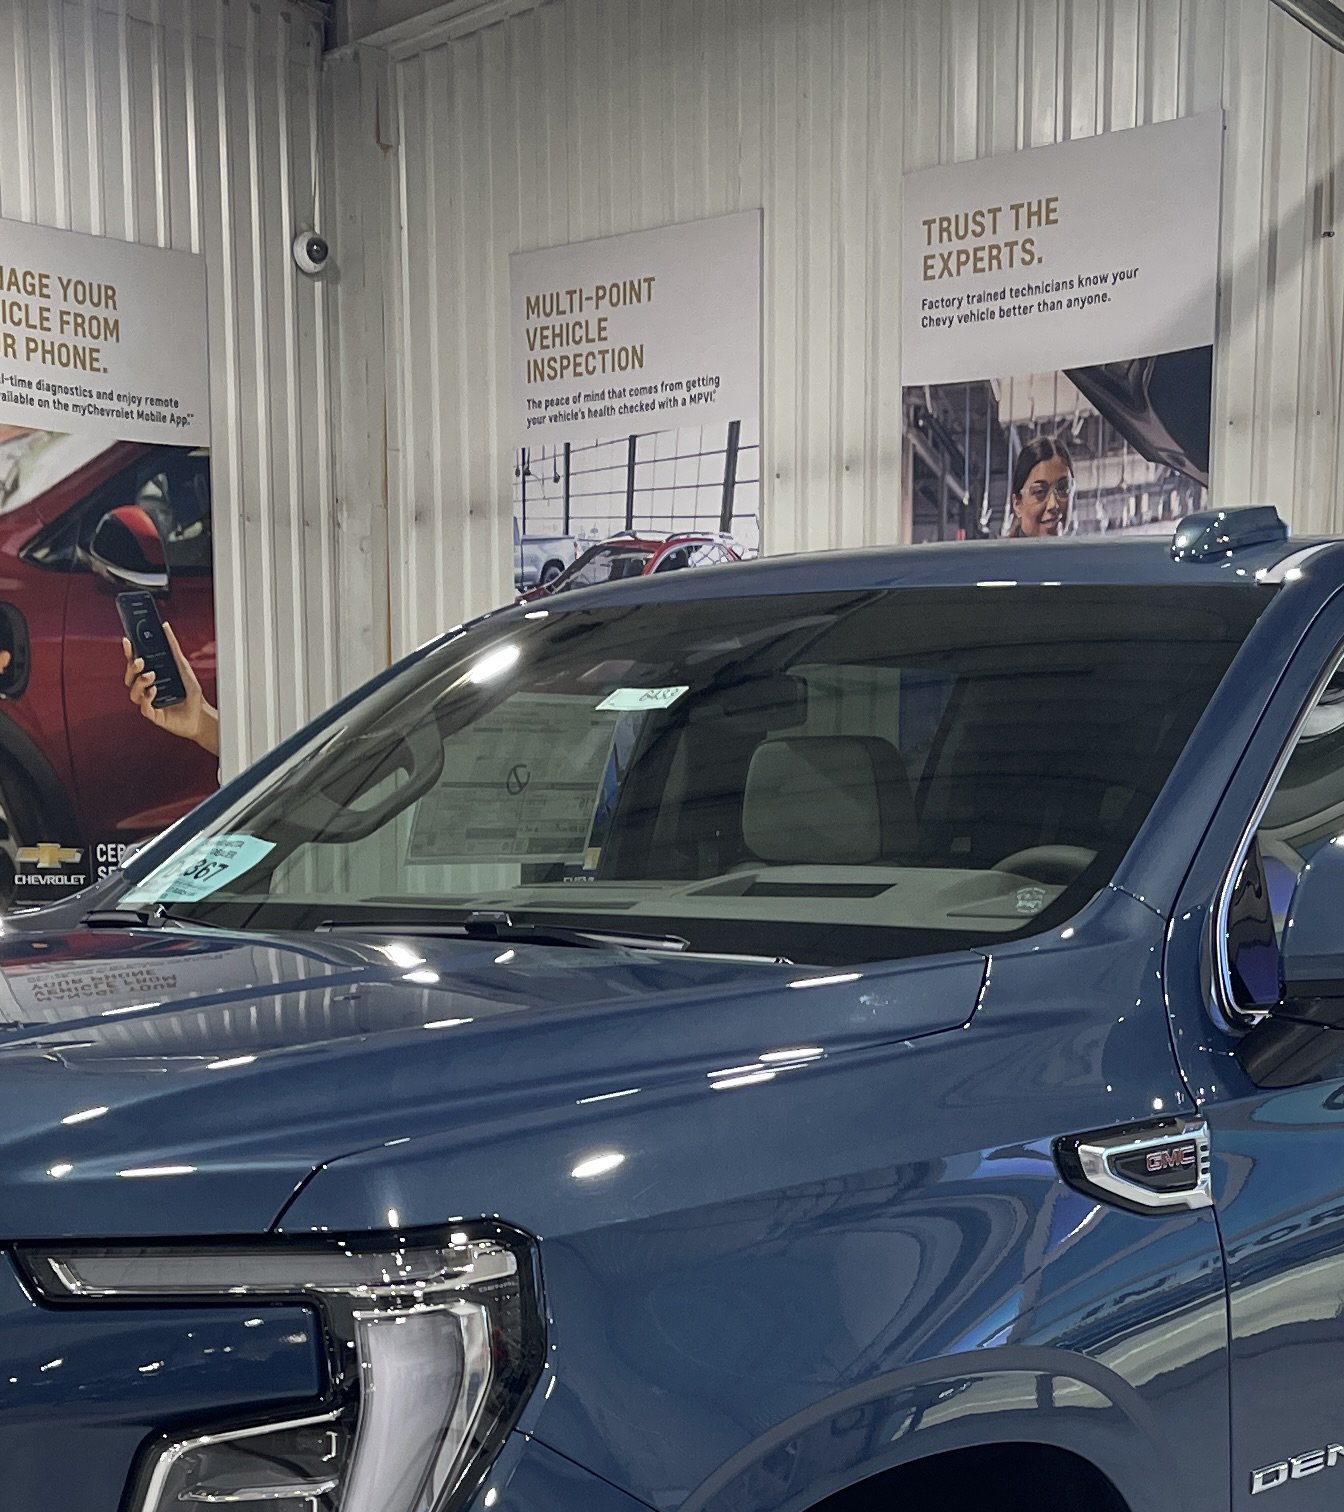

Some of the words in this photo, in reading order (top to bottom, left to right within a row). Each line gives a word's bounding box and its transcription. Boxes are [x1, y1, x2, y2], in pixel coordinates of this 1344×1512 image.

[922, 205, 1003, 246] TRUST
[1009, 196, 1059, 232] THE
[923, 237, 1044, 281] EXPERTS.
[58, 276, 118, 311] YOUR
[525, 276, 656, 320] MULTI-POINT
[921, 292, 964, 312] Factory
[966, 287, 1006, 305] trained
[1009, 278, 1075, 299] technicians
[1077, 272, 1108, 289] know
[1111, 267, 1140, 287] your
[59, 309, 120, 344] FROM
[921, 313, 955, 329] Chevy
[956, 306, 996, 325] vehicle
[998, 302, 1034, 319] better
[1037, 296, 1063, 313] than
[1066, 292, 1112, 310] anyone.
[525, 317, 608, 351] VEHICLE
[25, 336, 108, 374] PHONE.
[527, 344, 644, 384] INSPECTION
[35, 379, 94, 399] diagnostics
[96, 389, 114, 401] and
[116, 392, 143, 407] enjoy
[144, 396, 179, 409] remote
[526, 397, 542, 411] The
[544, 395, 570, 411] peace
[572, 391, 582, 404] of
[583, 389, 605, 403] mind
[607, 387, 627, 400] that
[628, 384, 658, 397] comes
[660, 380, 683, 393] from
[686, 374, 720, 393] getting
[37, 398, 50, 409] on
[52, 398, 70, 412] the
[71, 403, 135, 420] myChevrolet
[136, 409, 167, 424] Mobile
[526, 415, 546, 430] your
[548, 407, 586, 423] vehicle's
[587, 404, 616, 419] health
[618, 398, 656, 415] checked
[657, 395, 679, 410] with
[681, 397, 687, 407] a
[14, 874, 87, 886] CHEVROLET
[1146, 1145, 1195, 1172] GMC
